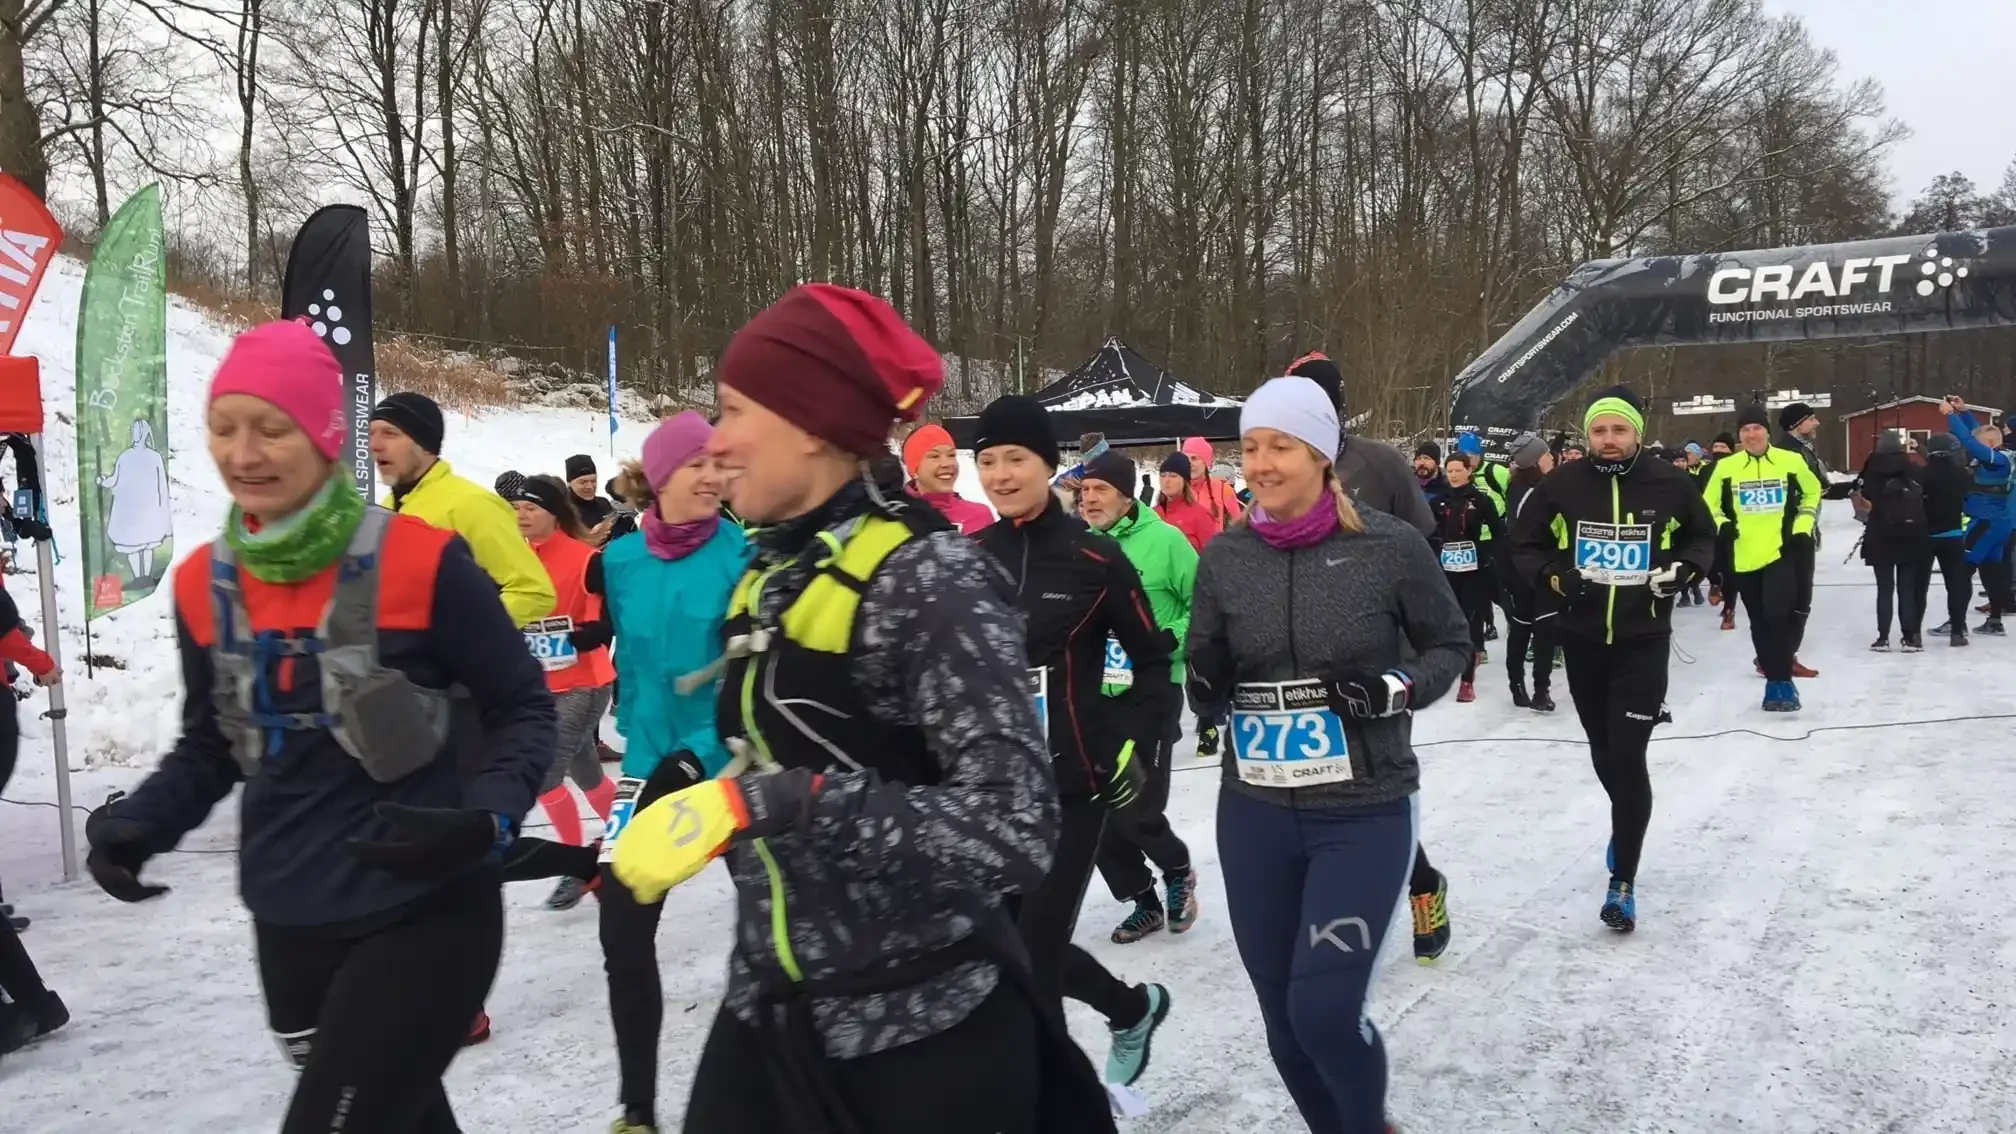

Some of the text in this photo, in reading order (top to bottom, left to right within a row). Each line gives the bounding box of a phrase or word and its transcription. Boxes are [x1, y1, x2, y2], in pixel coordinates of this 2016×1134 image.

[1708, 254, 1910, 304] CRAFT
[1709, 302, 1892, 323] FUNCTIONAL SPORTSWEAR
[1497, 311, 1579, 383] CRAFTSPORTSWEAR.COM
[355, 373, 369, 481] SPORTSWEAR
[1487, 426, 1512, 434] CRAFT
[1484, 452, 1509, 460] CRAFT
[1744, 490, 1777, 505] 281
[1445, 550, 1473, 564] 260
[1584, 541, 1641, 569] 290
[1284, 686, 1329, 701] etikhus
[1242, 712, 1331, 760] 273
[1293, 764, 1334, 778] CRAFT
